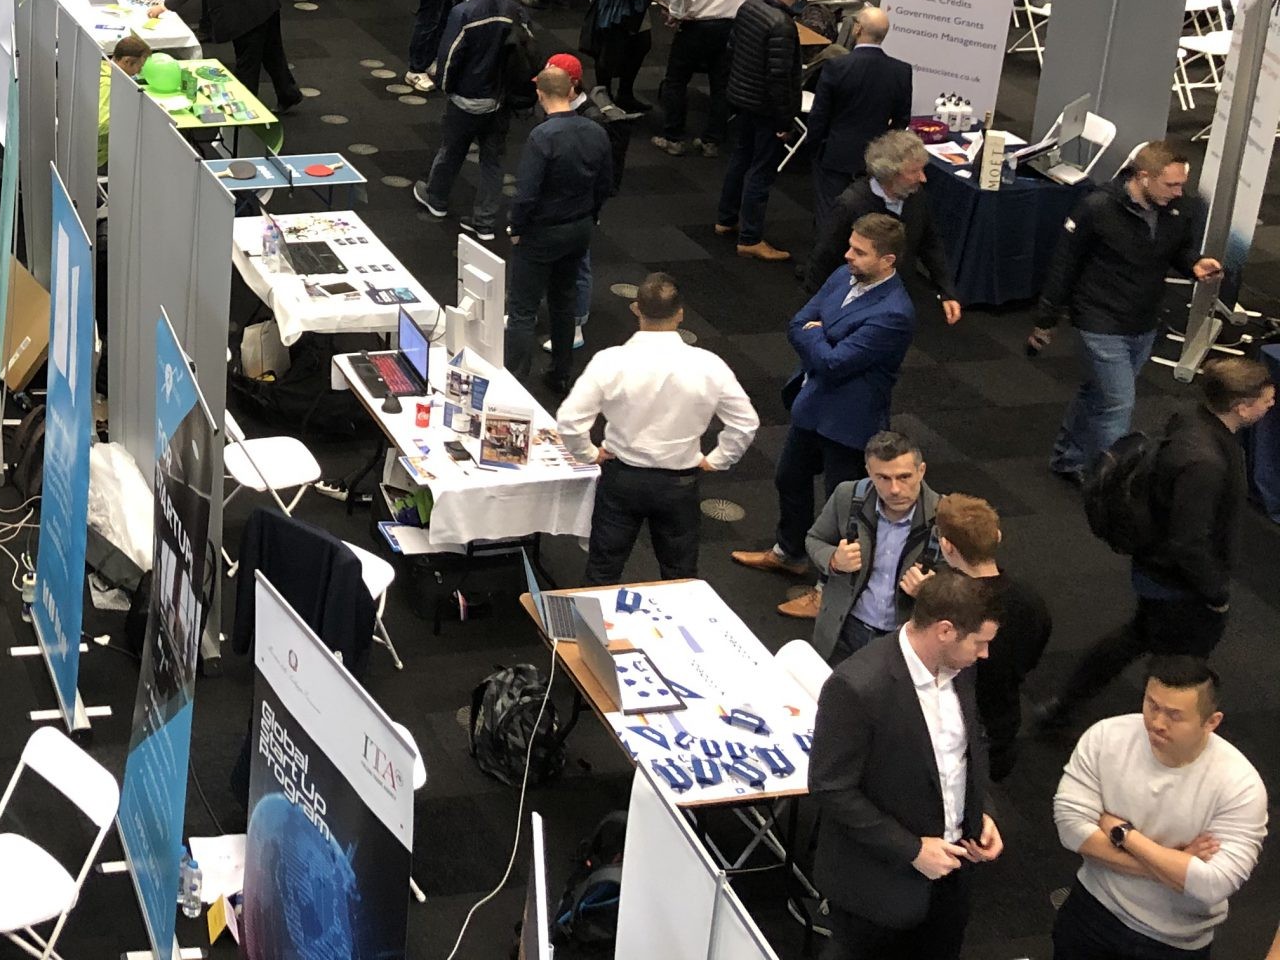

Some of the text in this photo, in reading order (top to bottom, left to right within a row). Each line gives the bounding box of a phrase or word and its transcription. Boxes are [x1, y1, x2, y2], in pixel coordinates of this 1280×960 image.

[892, 24, 998, 51] Innovation Management
[895, 6, 985, 30] Government Grants
[260, 717, 298, 783] Start
[301, 766, 327, 816] Up
[261, 700, 309, 774] Global
[362, 731, 397, 792] ITA
[259, 730, 331, 841] Program
